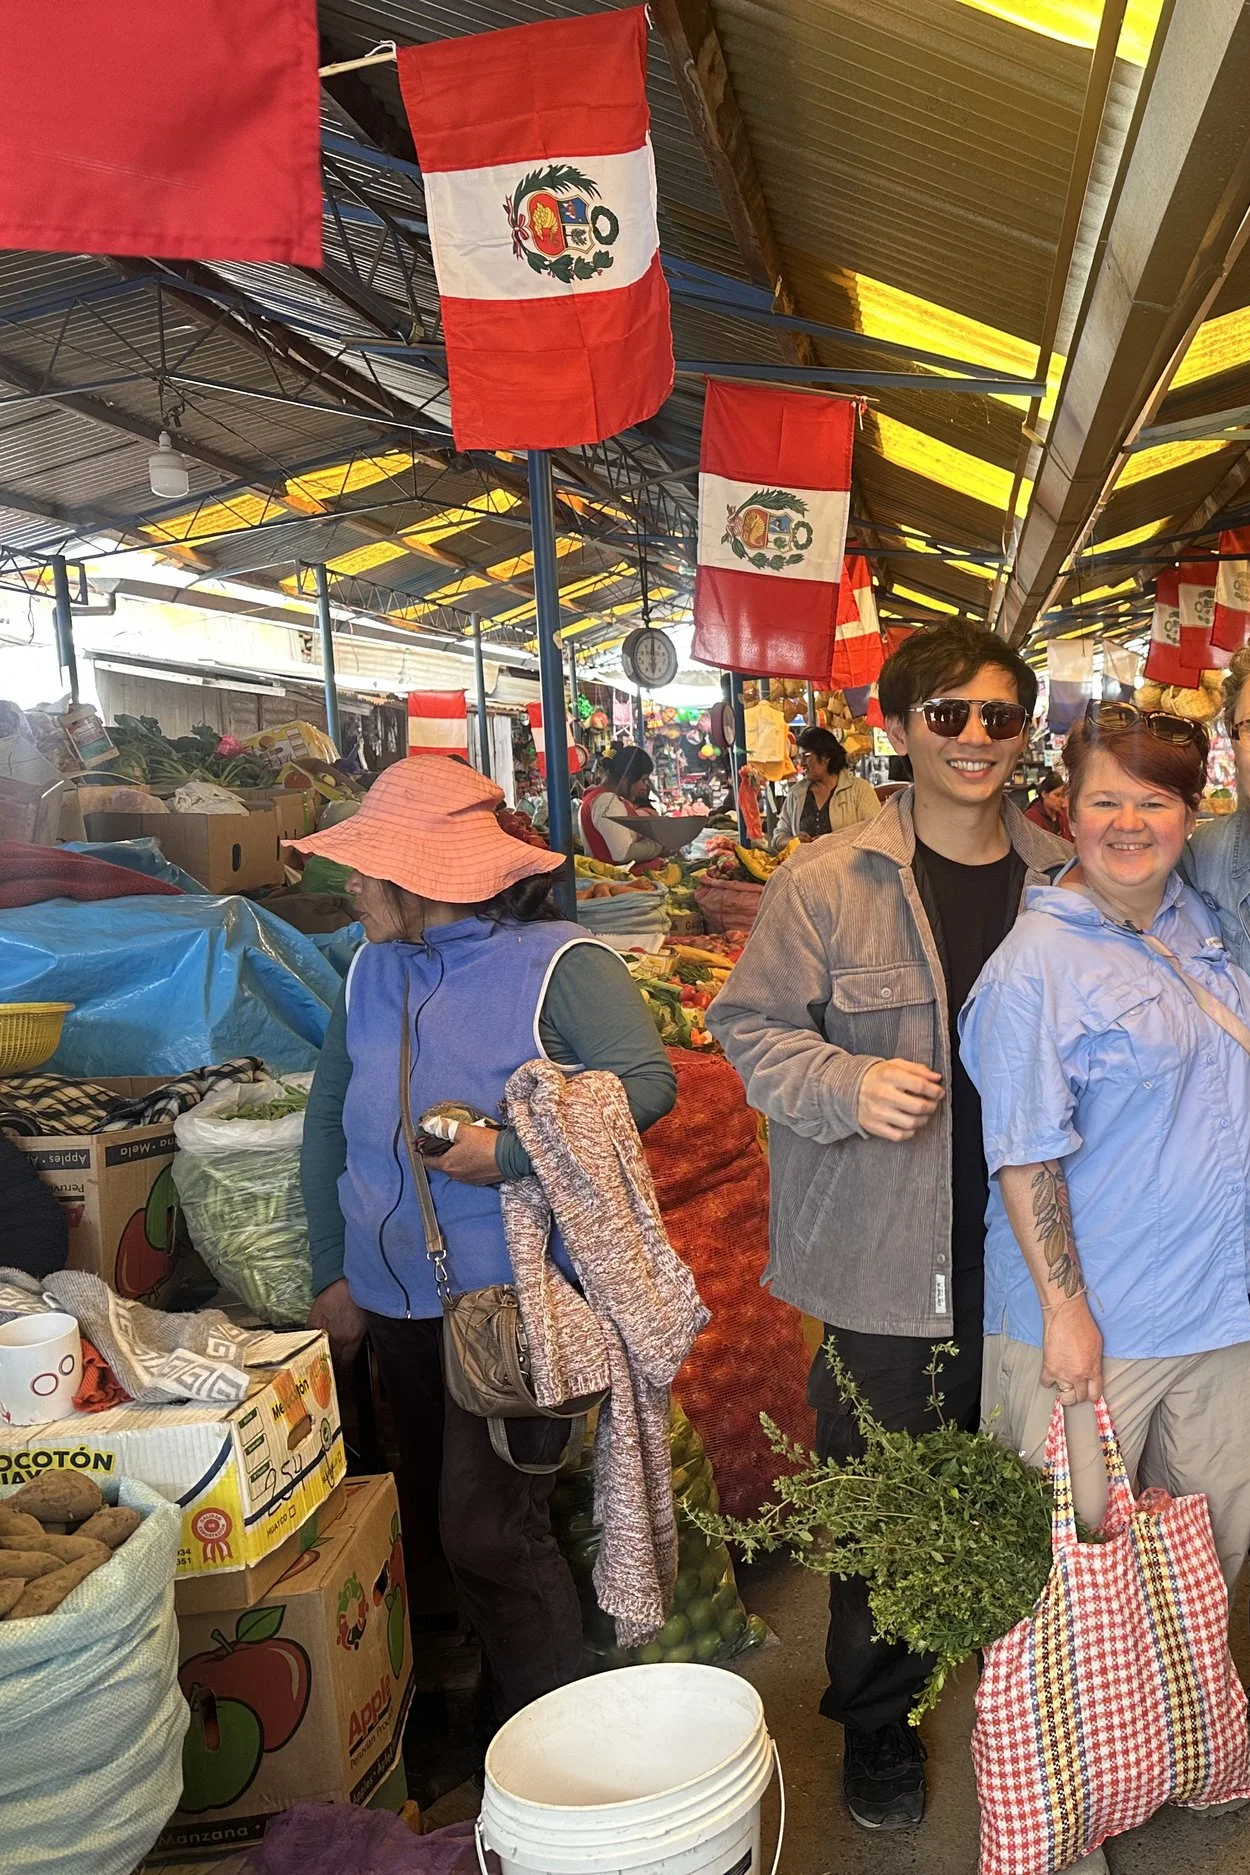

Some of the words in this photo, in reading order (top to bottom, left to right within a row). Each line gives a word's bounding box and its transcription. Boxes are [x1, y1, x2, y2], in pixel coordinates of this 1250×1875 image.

[120, 1142, 151, 1156] Mela
[49, 1154, 87, 1167] Apples
[266, 1514, 288, 1537] HUAYCO
[349, 1674, 392, 1749] Apple
